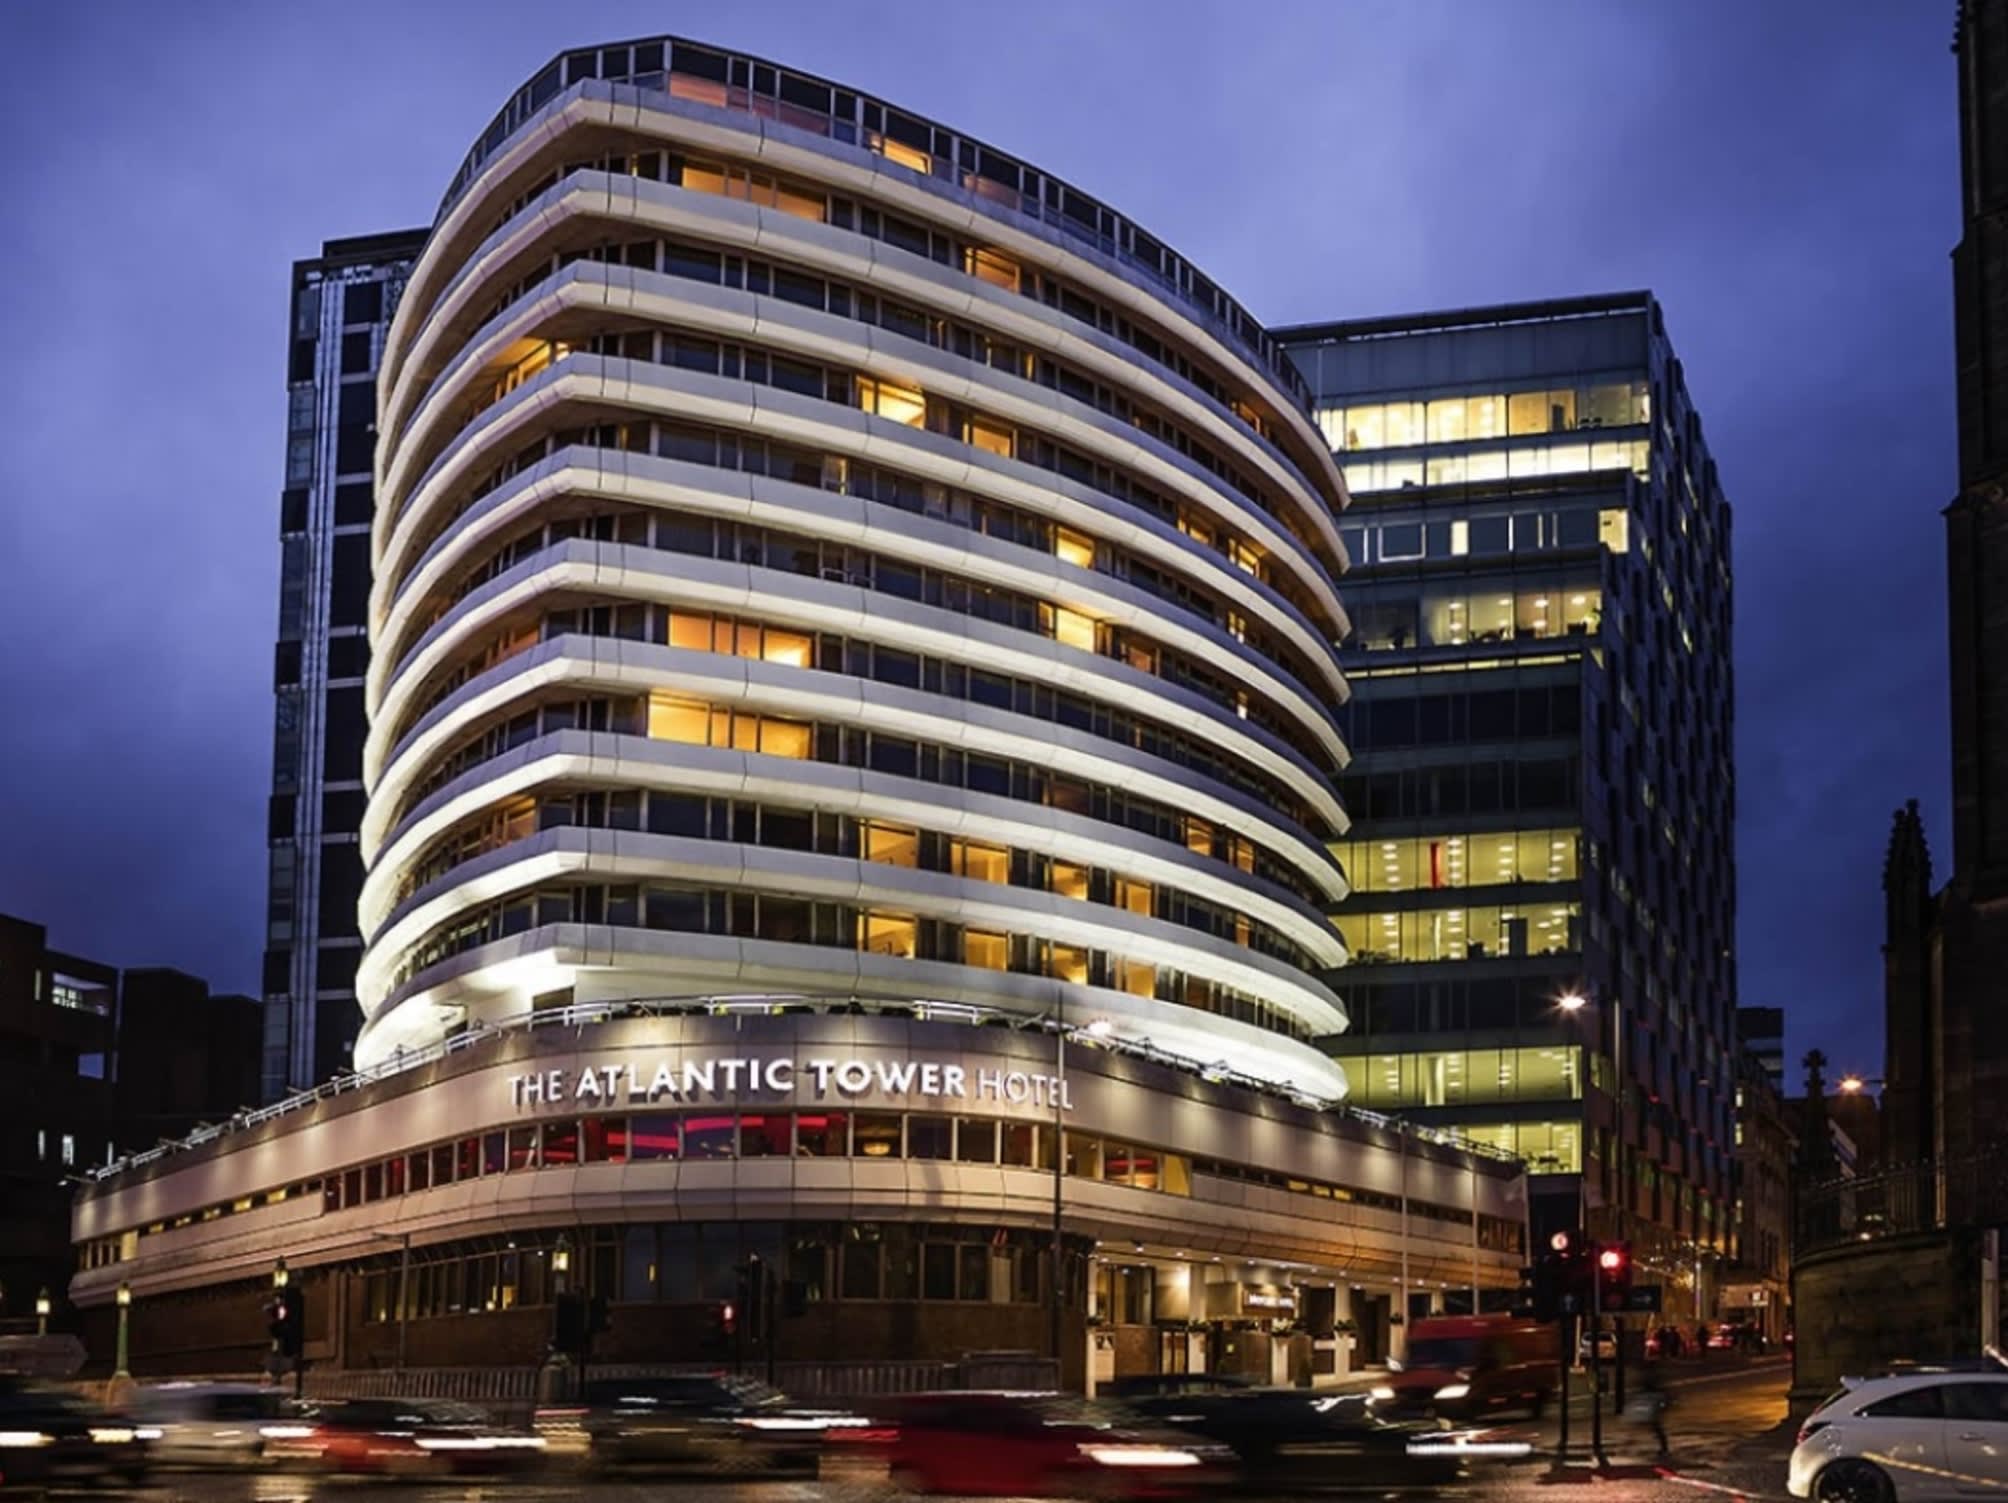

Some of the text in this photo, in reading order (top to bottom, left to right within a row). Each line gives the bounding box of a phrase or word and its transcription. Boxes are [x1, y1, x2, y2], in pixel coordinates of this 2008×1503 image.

[507, 1058, 1073, 1110] THE ATLANTIC TOWER HOTEL
